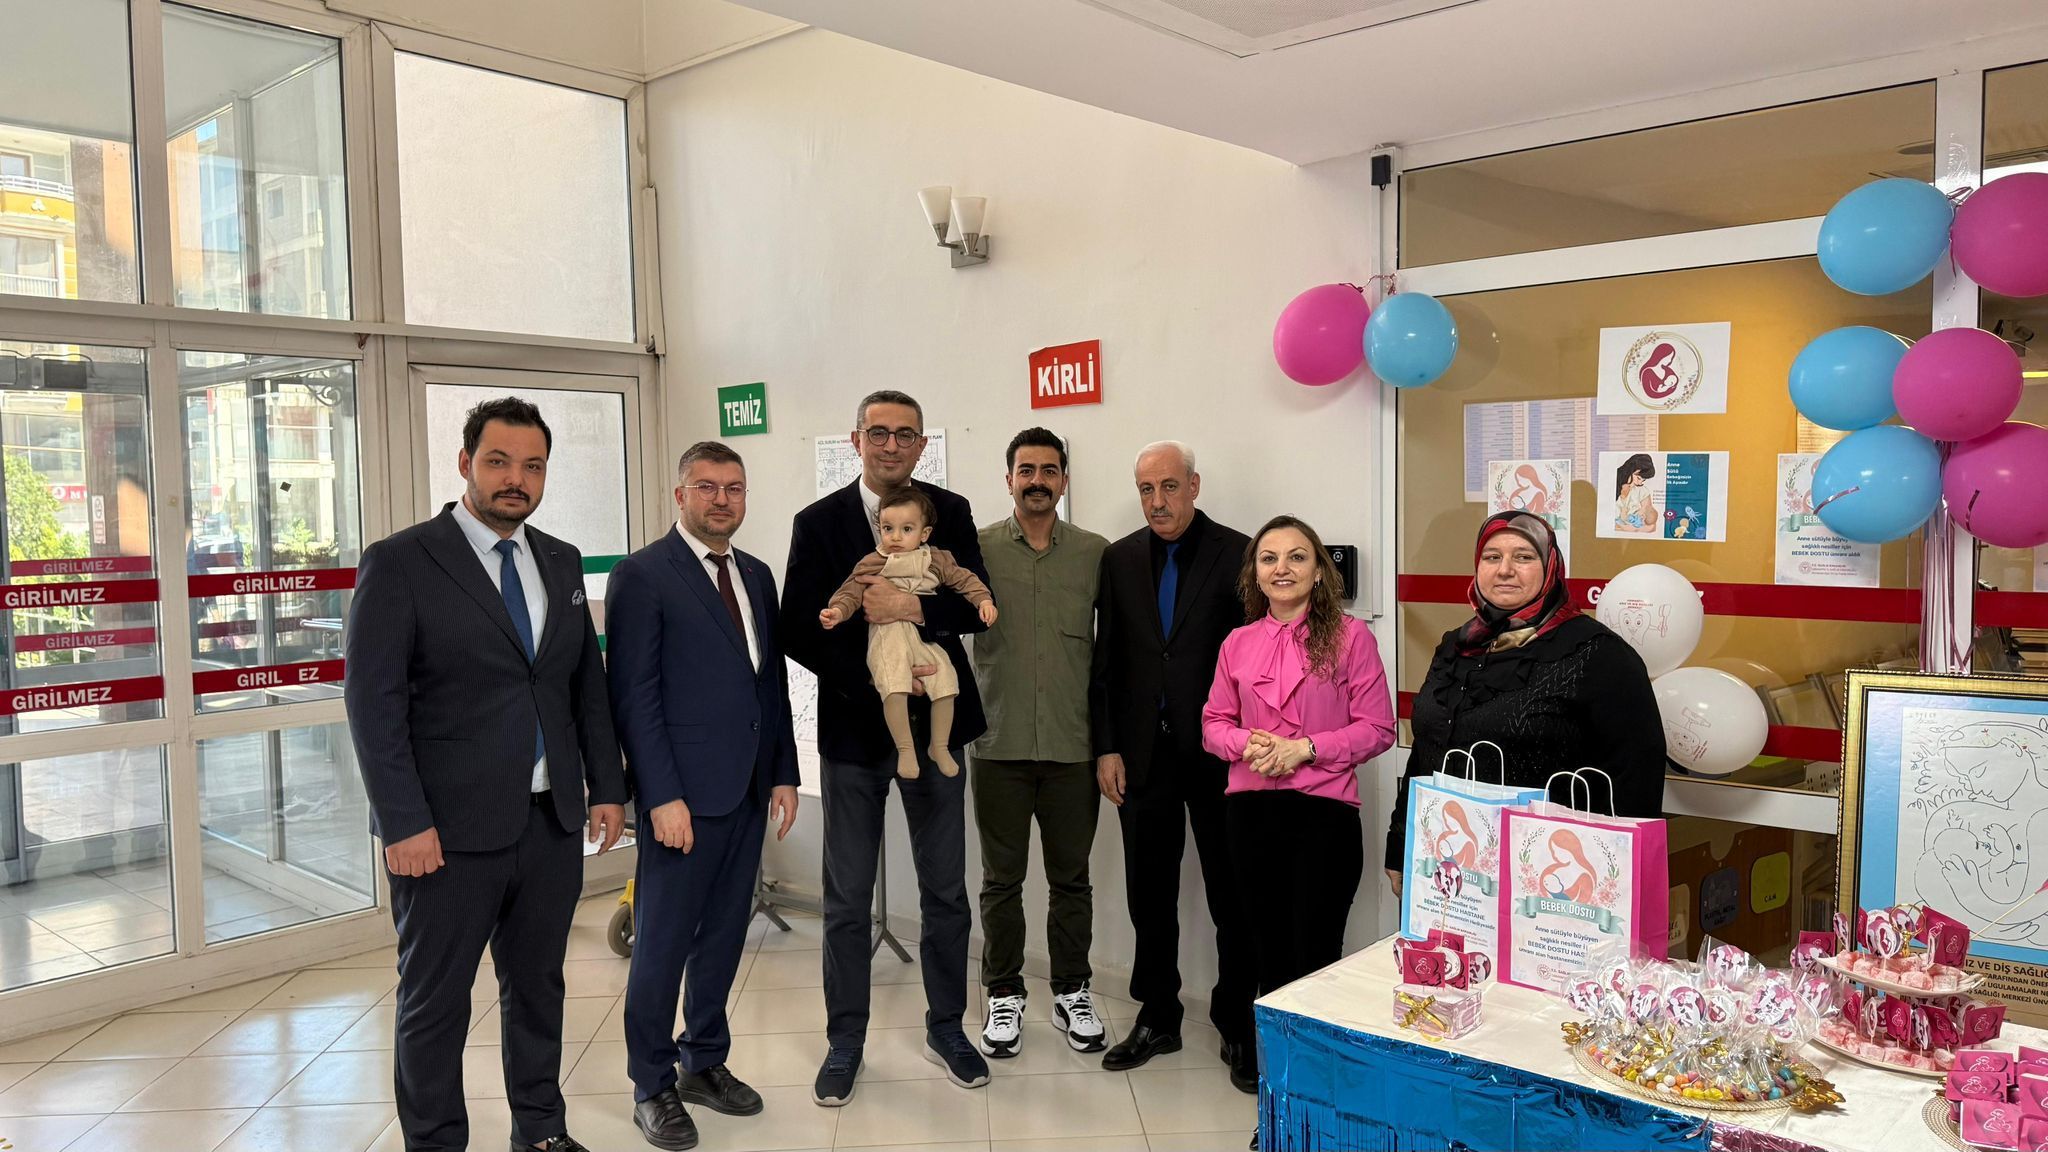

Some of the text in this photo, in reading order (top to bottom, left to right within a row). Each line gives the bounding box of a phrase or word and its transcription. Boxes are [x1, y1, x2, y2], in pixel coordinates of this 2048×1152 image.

[1038, 353, 1094, 397] KİRLİ
[724, 393, 762, 427] TEMİZ
[43, 560, 114, 574] GİRİLMEZ
[233, 574, 316, 592] GİRİLMEZ
[5, 586, 105, 607] GİRİLMEZ
[45, 633, 115, 649] GİRİLMEZ
[12, 686, 112, 711] GİRİLMEZ
[1541, 900, 1596, 919] BEBEK DOSTU
[1535, 925, 1599, 943] Anne sütüyle büyüyen
[1528, 940, 1546, 951] BEBEK
[1548, 945, 1569, 955] DOSTU
[1977, 960, 1991, 970] VE
[1993, 962, 2011, 975] DİŞ
[1974, 989, 2000, 998] SAĞLIĞI
[2001, 993, 2032, 1003] MERKEZİ
